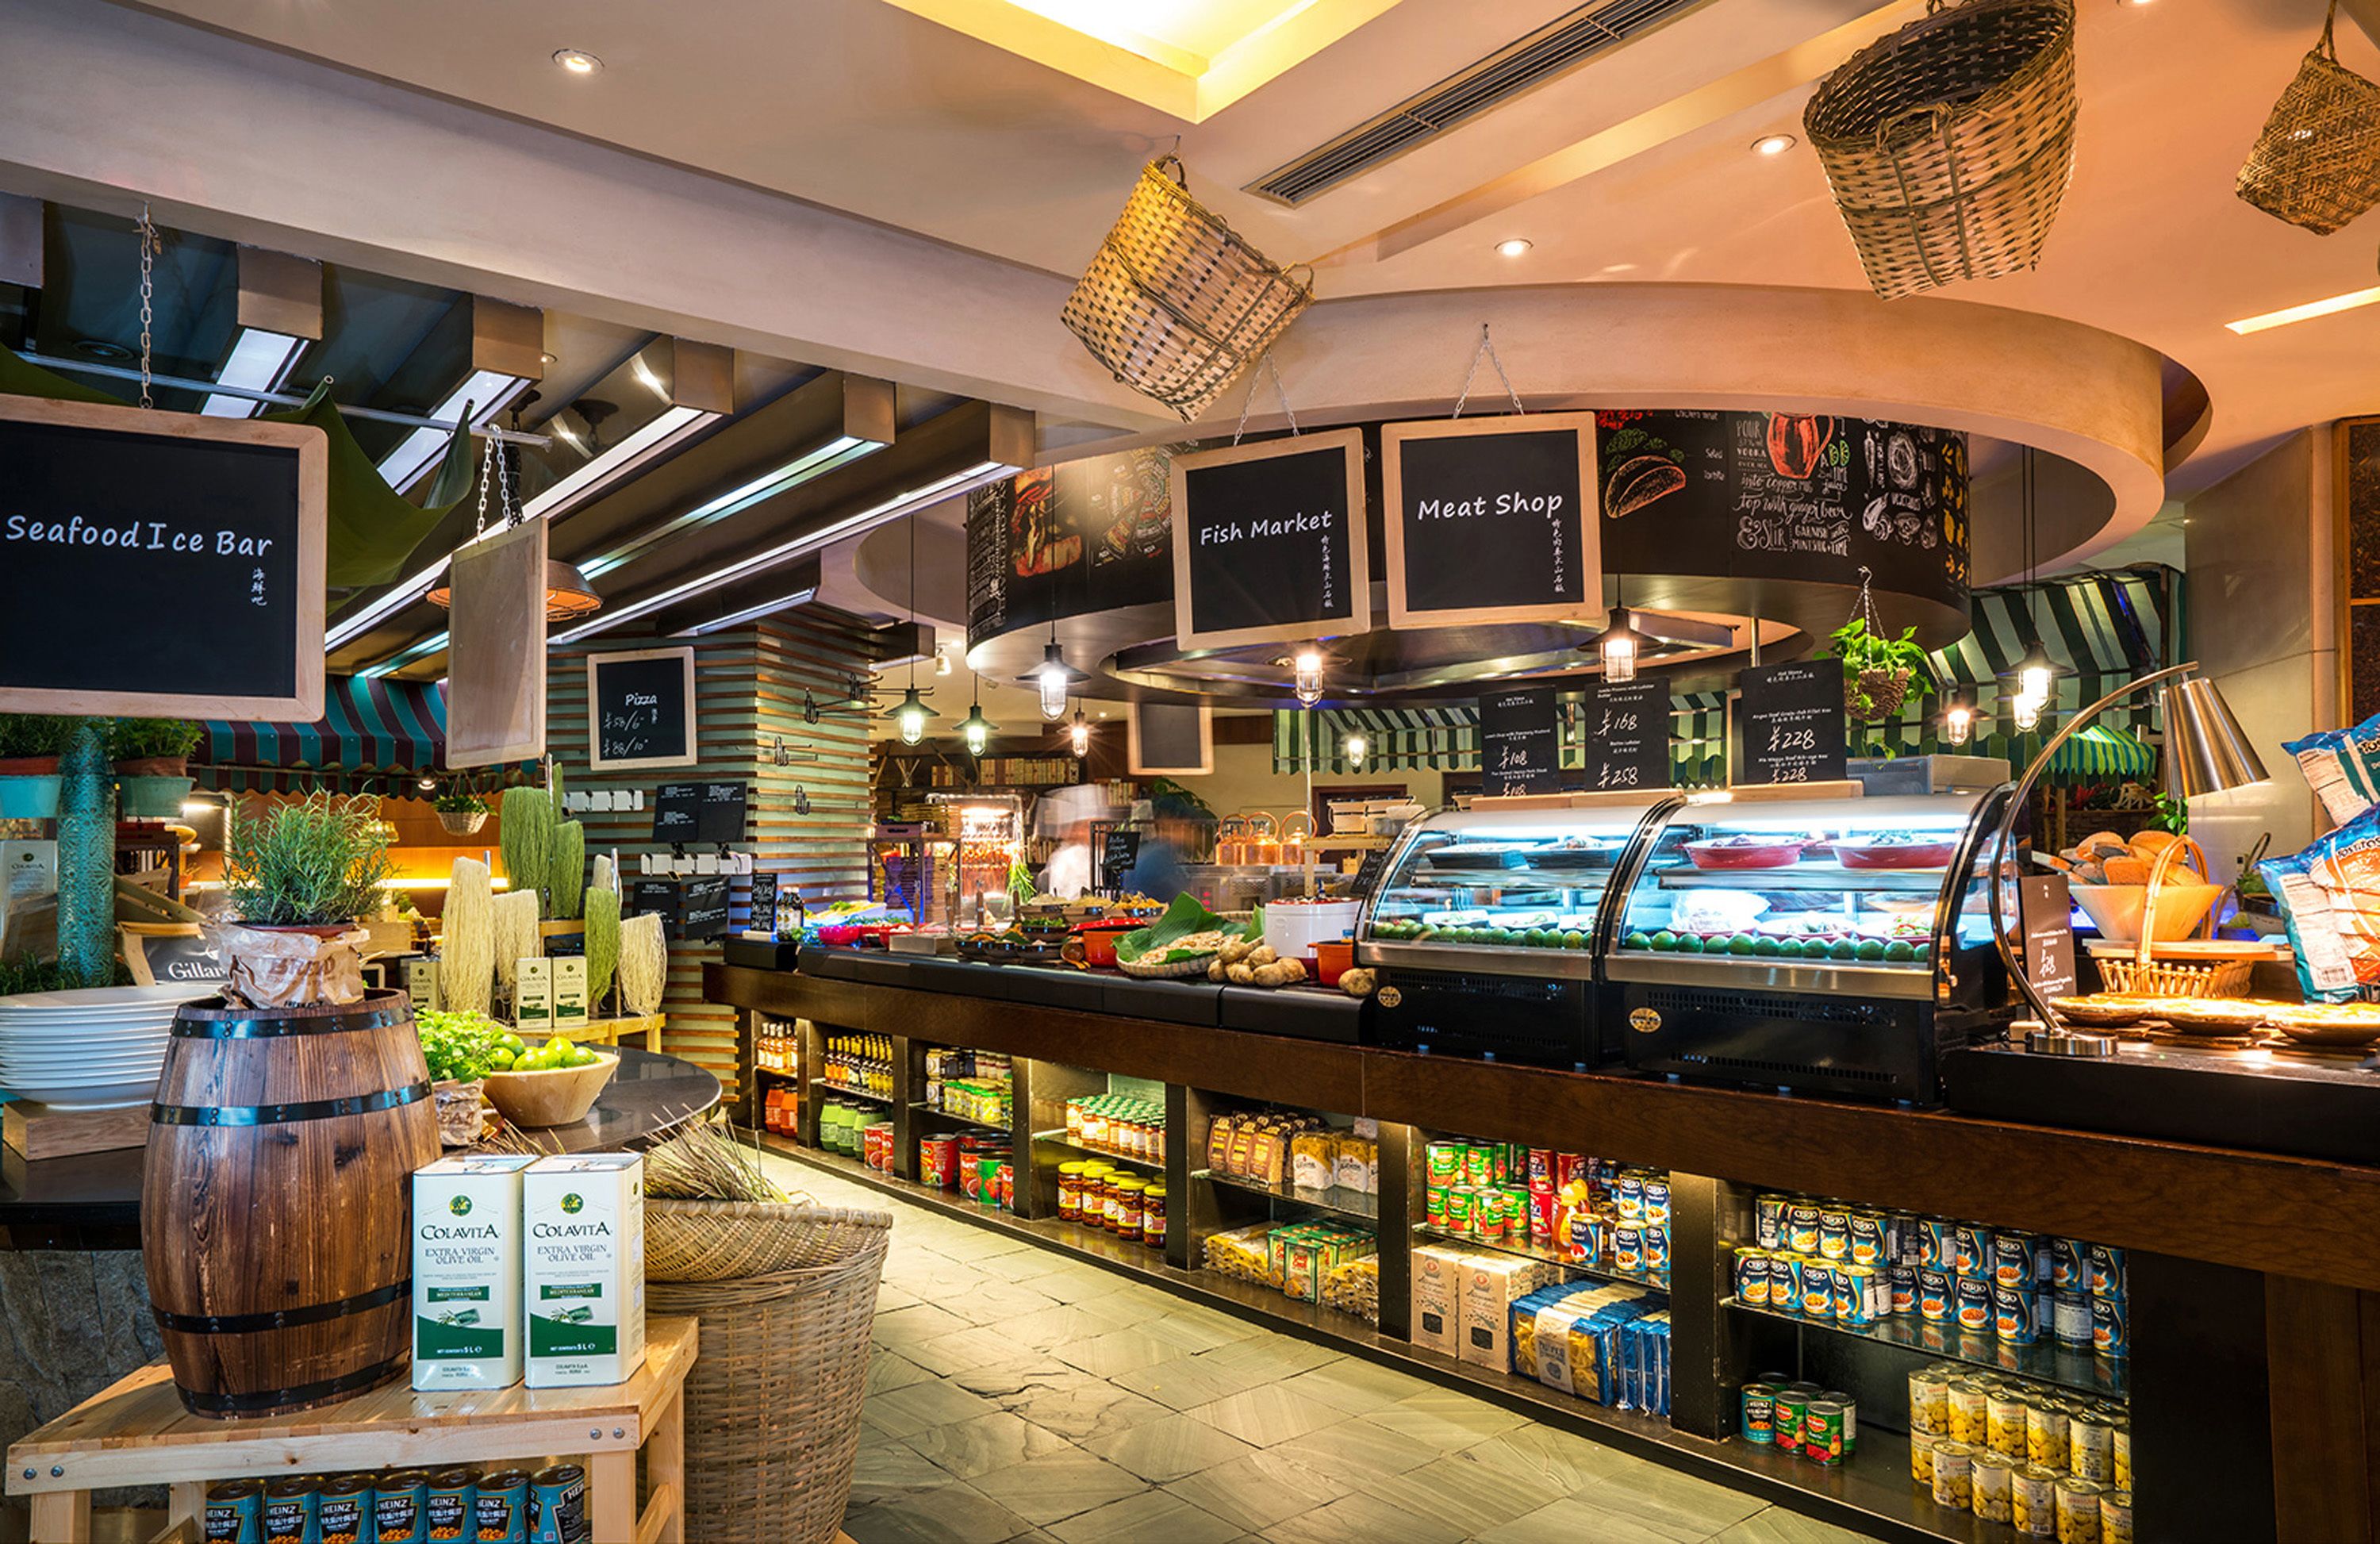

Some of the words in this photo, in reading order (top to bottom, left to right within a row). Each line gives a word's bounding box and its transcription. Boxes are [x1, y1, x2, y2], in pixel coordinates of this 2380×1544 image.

[1418, 494, 1487, 520] Meat
[1495, 490, 1564, 518] Shop
[1200, 524, 1243, 546] Fish
[1250, 509, 1333, 539] Market
[5, 515, 140, 548] Seafood
[146, 522, 205, 552] Ice
[216, 530, 274, 556] Bar
[625, 692, 658, 706] Pizza
[1597, 708, 1637, 736] ¥168
[1767, 725, 1817, 752] ¥228
[1597, 762, 1638, 789] ¥258
[168, 962, 226, 981] Gillar
[420, 1223, 499, 1241] COLAVITA
[532, 1221, 611, 1239] COLAVITA
[424, 1247, 459, 1258] EXTRA
[460, 1246, 495, 1257] VIRGIN
[537, 1245, 570, 1255] EXTRA
[573, 1243, 607, 1254] VIRGIN
[436, 1255, 465, 1265] OLIVE
[466, 1255, 484, 1264] OIL
[547, 1253, 578, 1262] OLIVE
[579, 1252, 596, 1262] OIL
[323, 1503, 354, 1515] HEINZ
[378, 1498, 409, 1511] HEINZ
[430, 1497, 457, 1507] HEINZ
[477, 1499, 501, 1509] HEINZ
[268, 1505, 297, 1515] HEINZ
